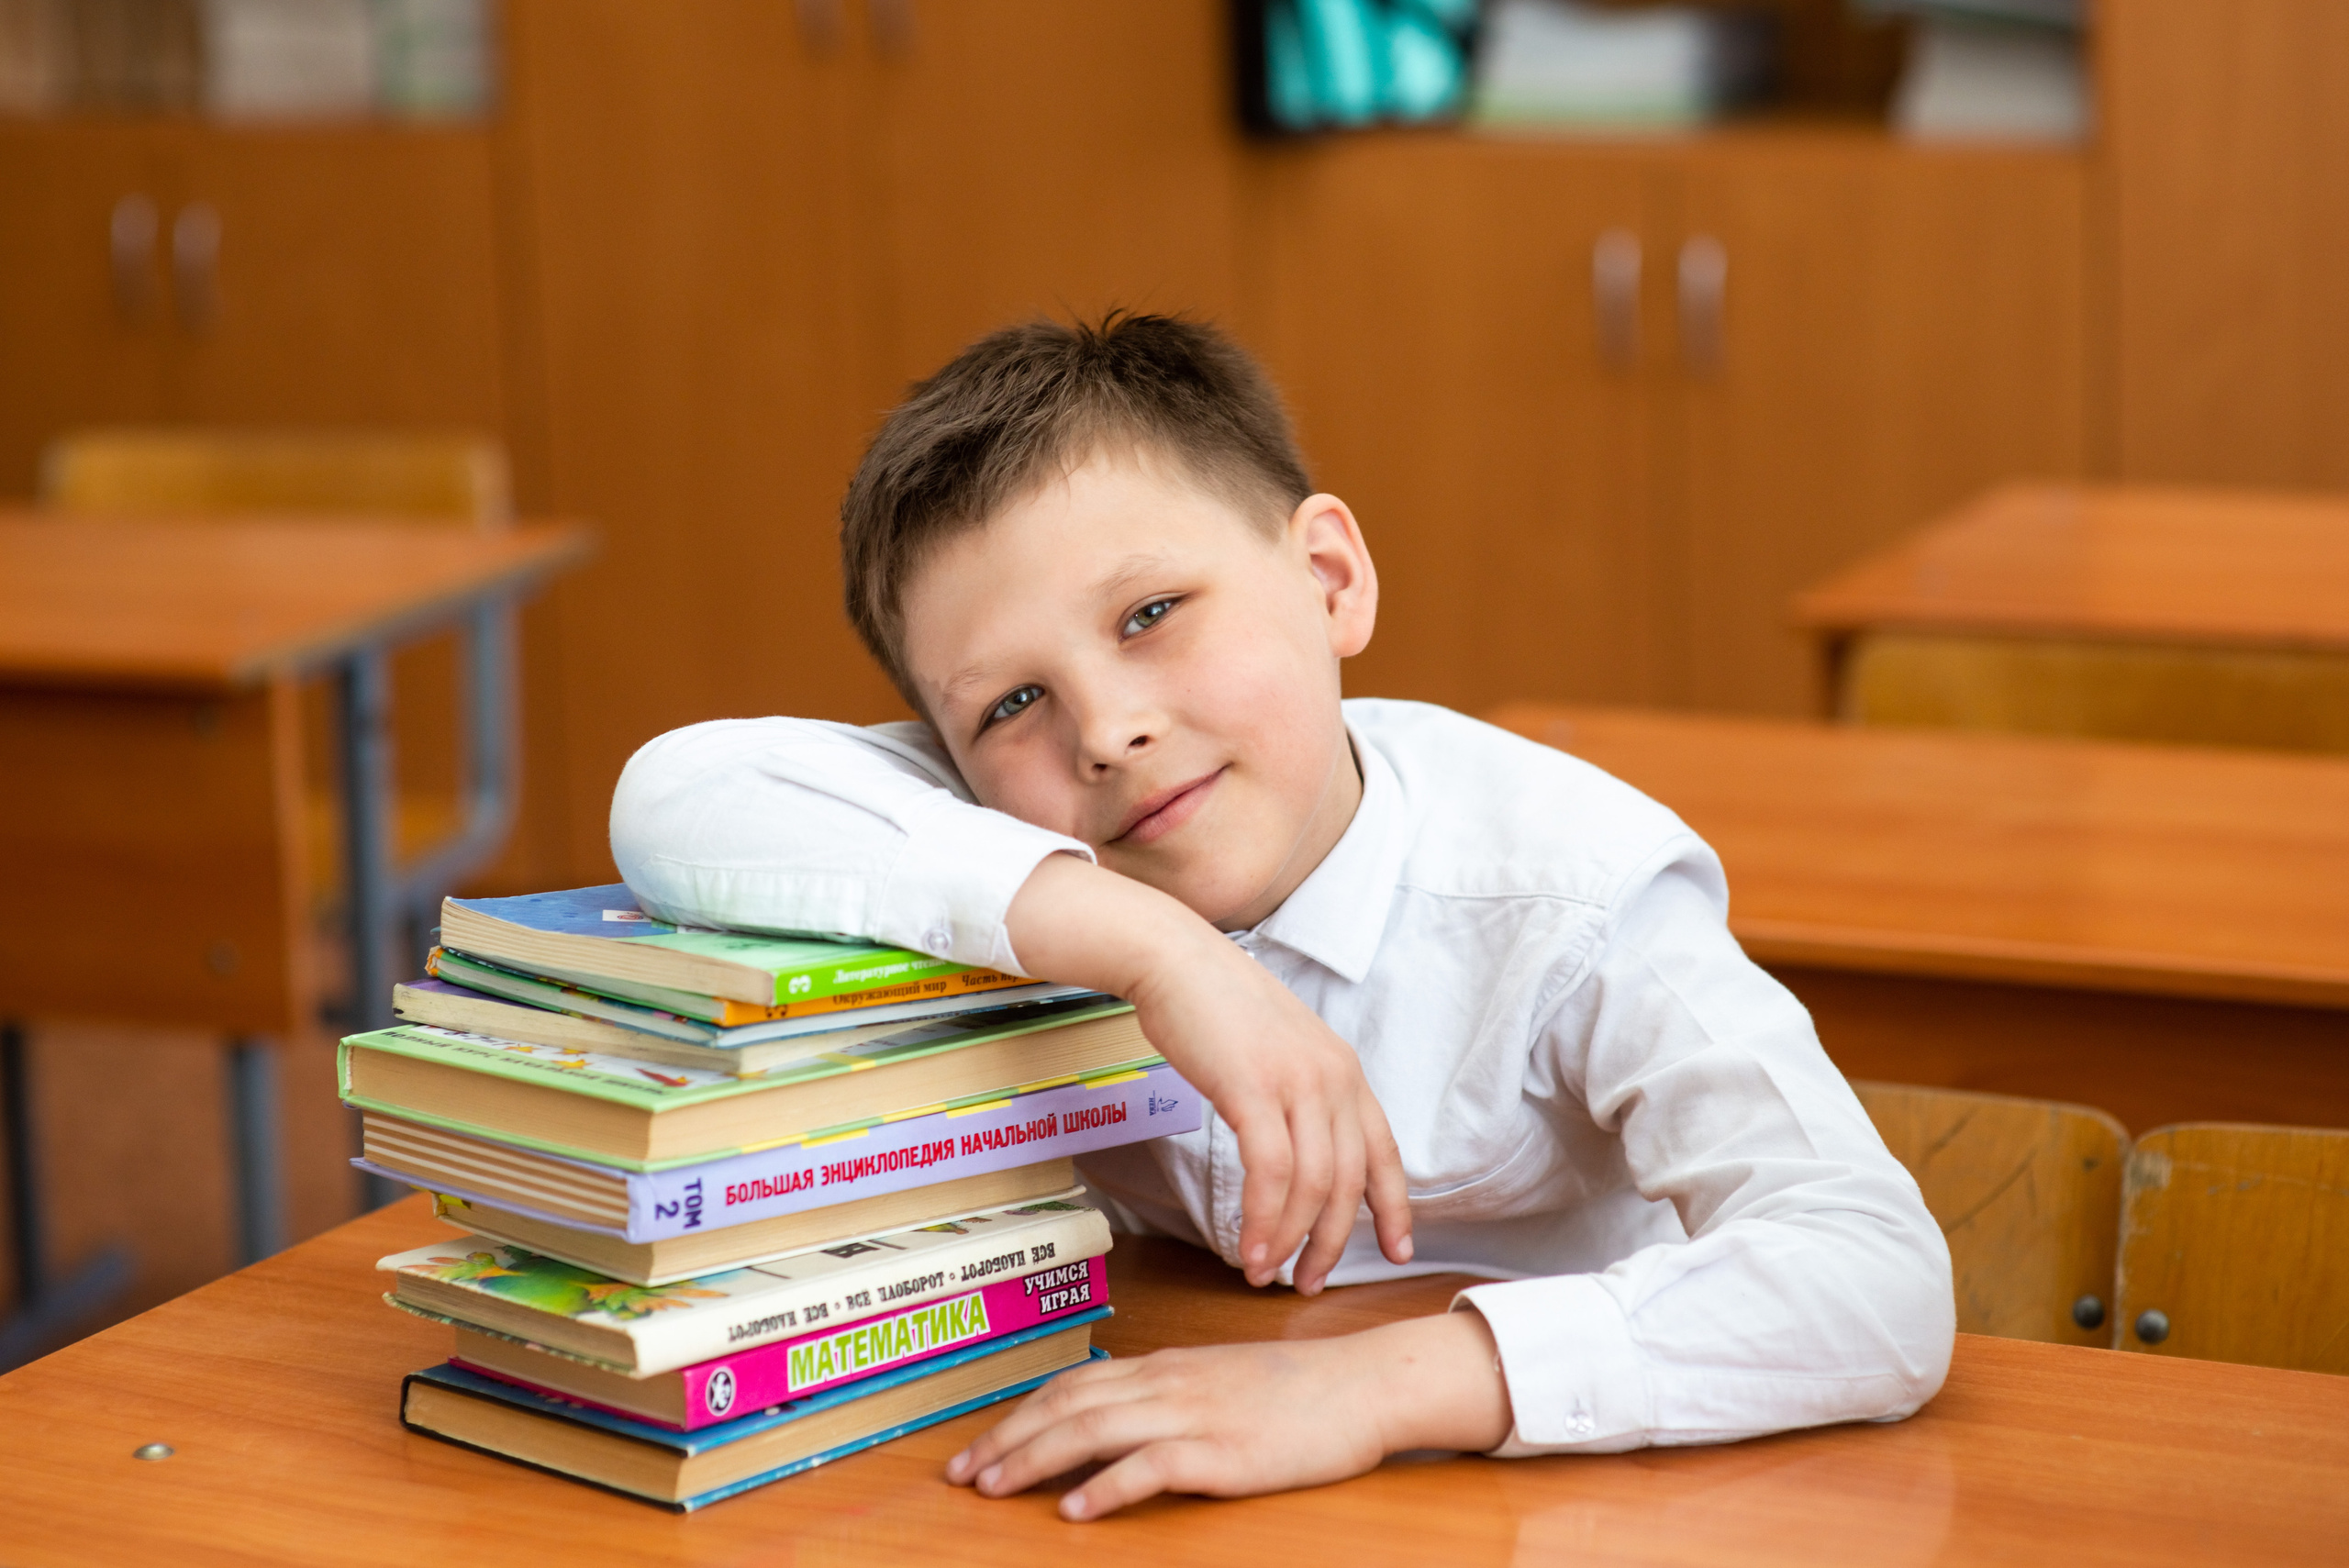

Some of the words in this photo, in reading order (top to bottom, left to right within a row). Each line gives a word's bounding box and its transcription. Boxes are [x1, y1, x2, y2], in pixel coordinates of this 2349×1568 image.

[788, 974, 812, 995] 3
[833, 962, 909, 984] Литературное
[833, 981, 920, 1005] Окружающий
[923, 981, 947, 993] мир
[962, 974, 997, 986] Часть
[725, 1168, 814, 1207] БОЛЬШАЯ
[820, 1138, 955, 1186] ЭНЦИКЛОПЕДИЯ
[961, 1112, 1058, 1156] НАЧАЛЬНОЙ
[1063, 1101, 1127, 1134] ШКОЛЫ
[655, 1200, 680, 1221] 2
[683, 1177, 703, 1229] ТОМ
[961, 1250, 1026, 1282] НАОБОРОТ
[1024, 1261, 1089, 1296] УЧИМСЯ
[877, 1272, 944, 1302] НАОБОРОТ
[1040, 1283, 1091, 1314] ИГРАЯ
[788, 1292, 990, 1392] МАТЕМАТИКА
